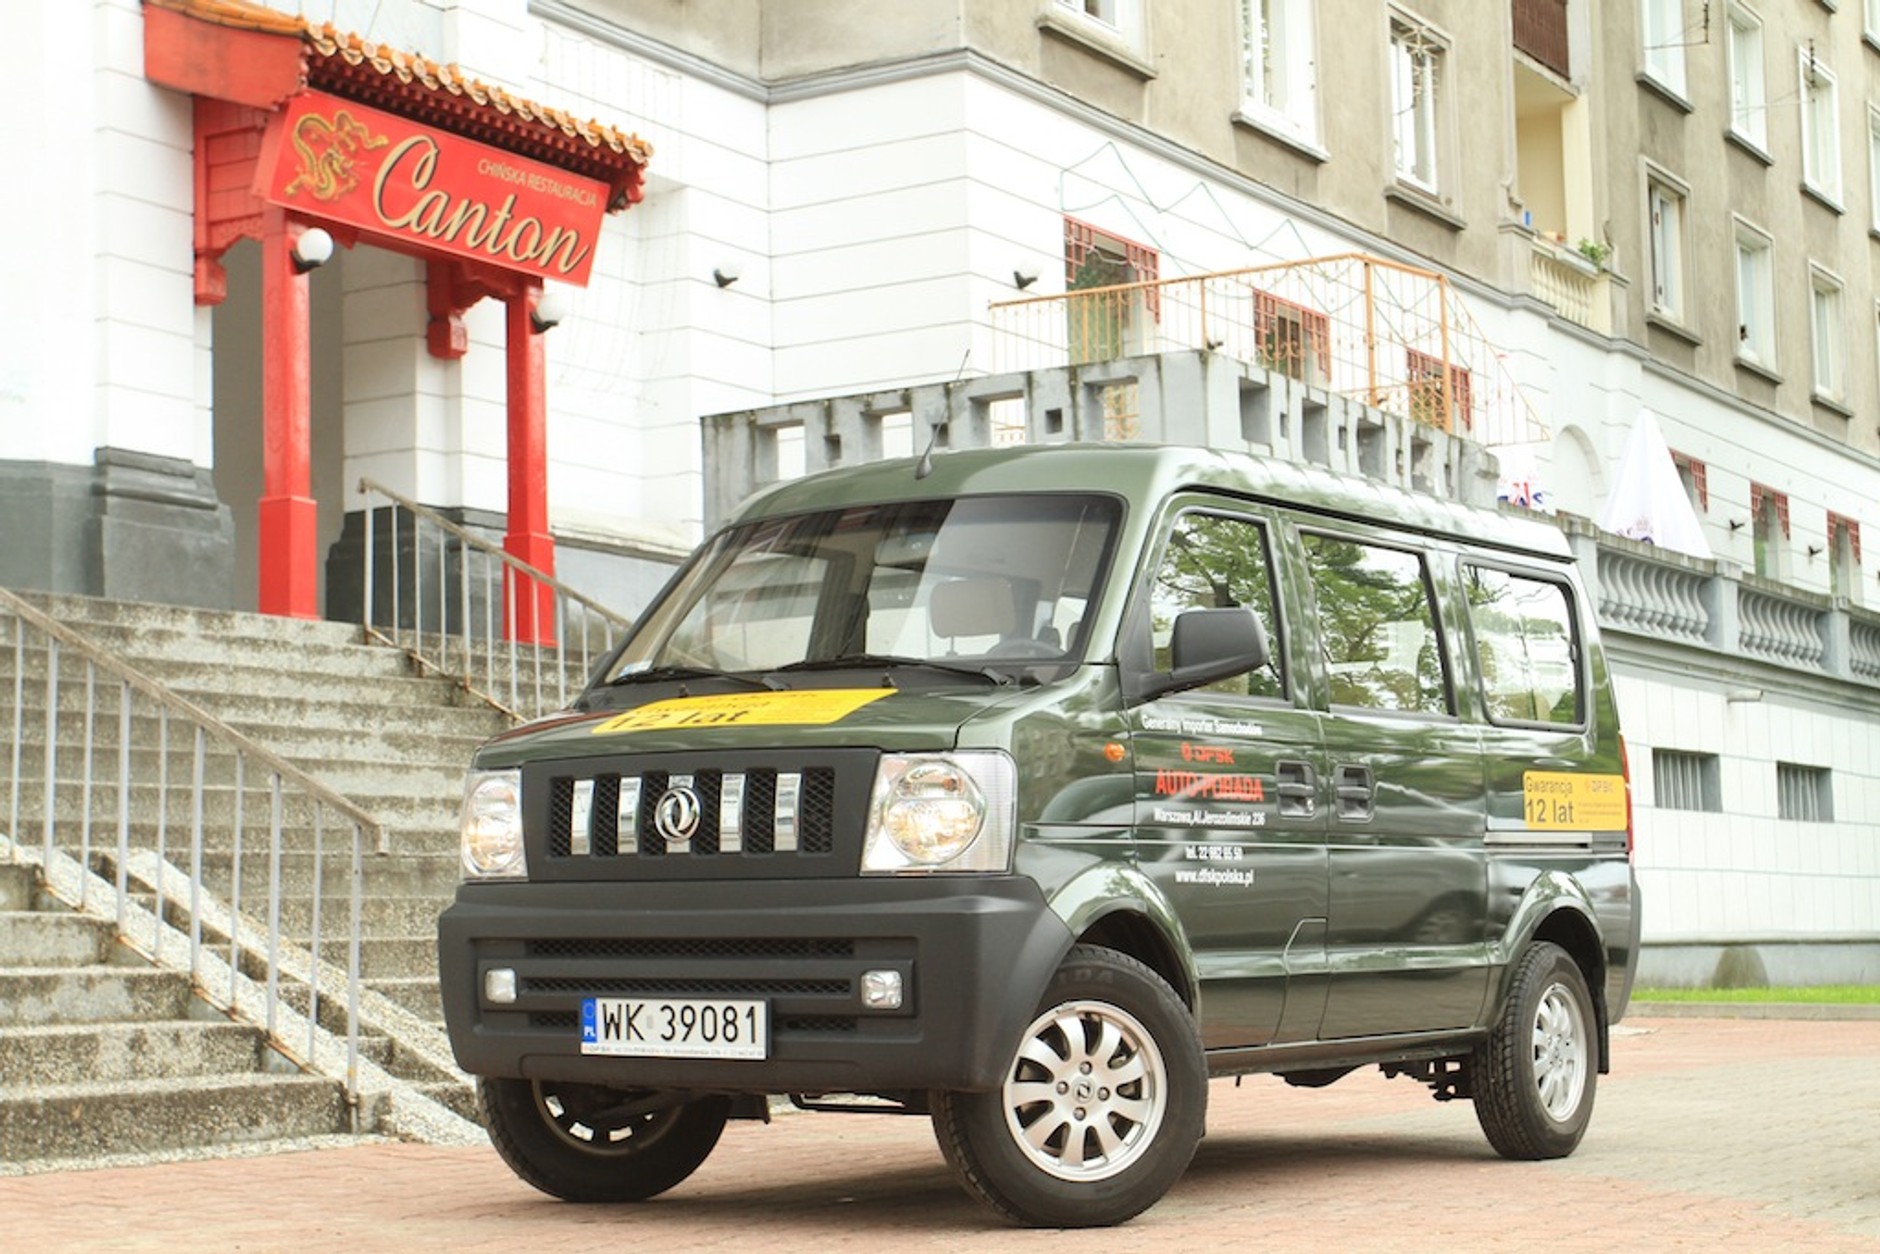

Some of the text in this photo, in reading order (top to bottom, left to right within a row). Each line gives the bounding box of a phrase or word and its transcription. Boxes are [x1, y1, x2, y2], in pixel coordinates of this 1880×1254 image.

[477, 158, 598, 208] CHIŃSKA RESTAURACJA
[373, 135, 590, 273] Canton
[1526, 798, 1547, 823] 12
[1553, 799, 1574, 823] lat
[584, 1026, 595, 1037] PL
[602, 1003, 757, 1044] WK 39081
